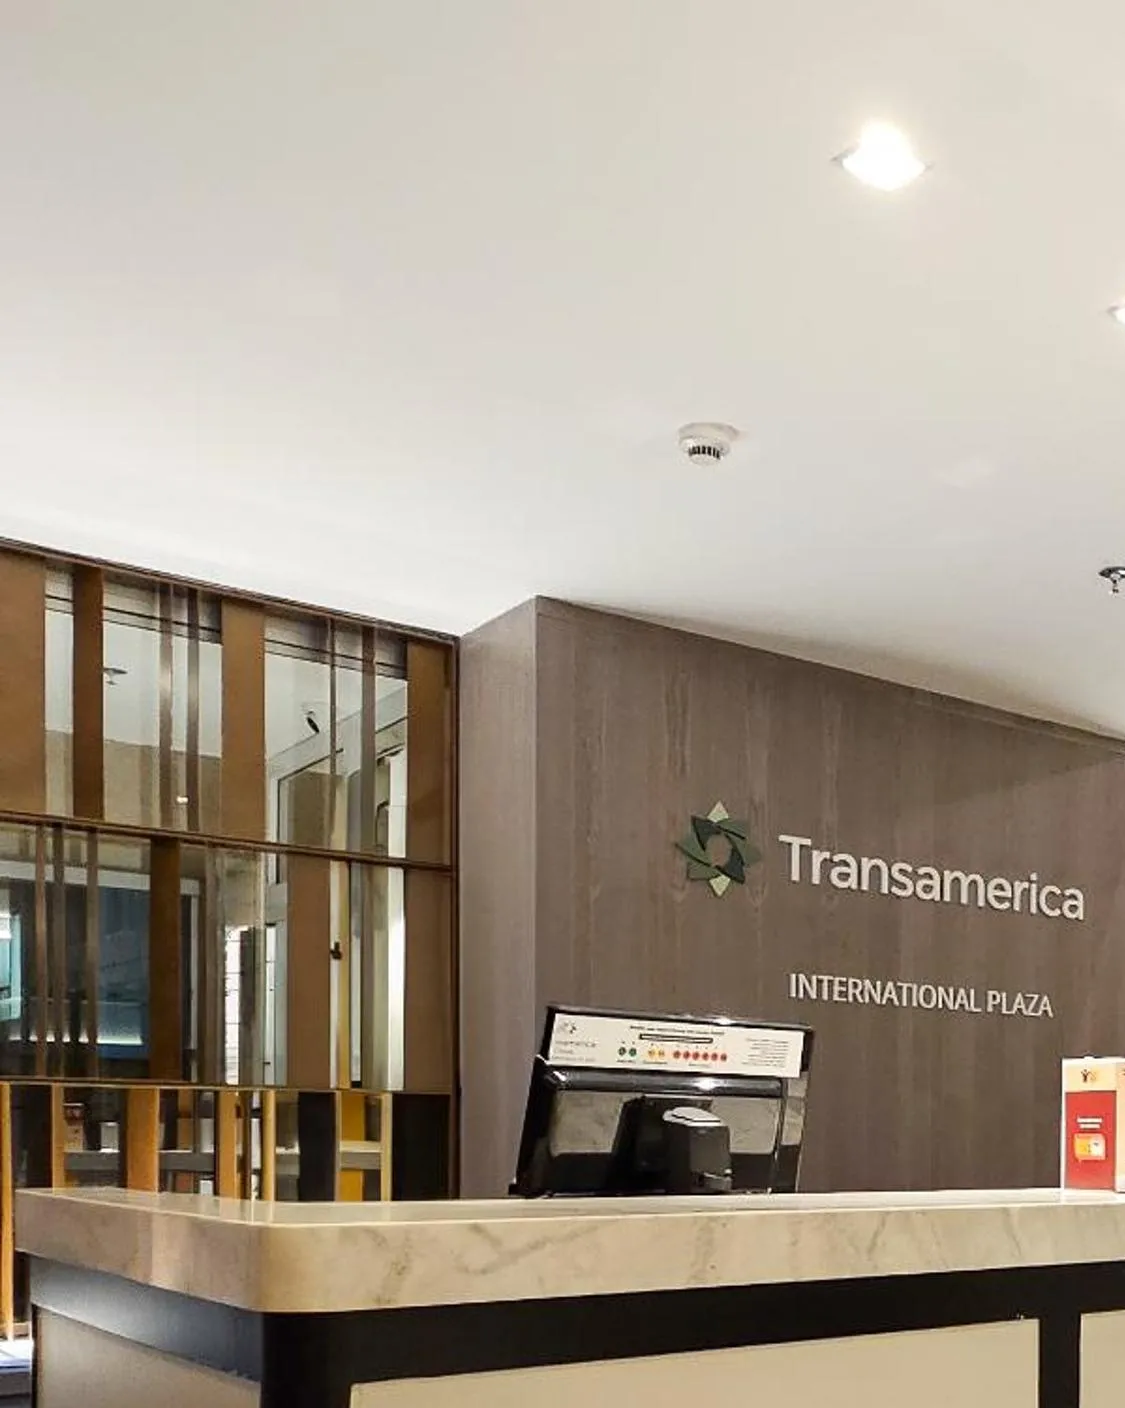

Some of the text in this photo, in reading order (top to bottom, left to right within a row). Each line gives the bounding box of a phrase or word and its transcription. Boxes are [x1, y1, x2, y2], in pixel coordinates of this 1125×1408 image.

[778, 834, 1086, 921] Transamerica
[789, 972, 1054, 1018] INTERNATIONAL PLAZA
